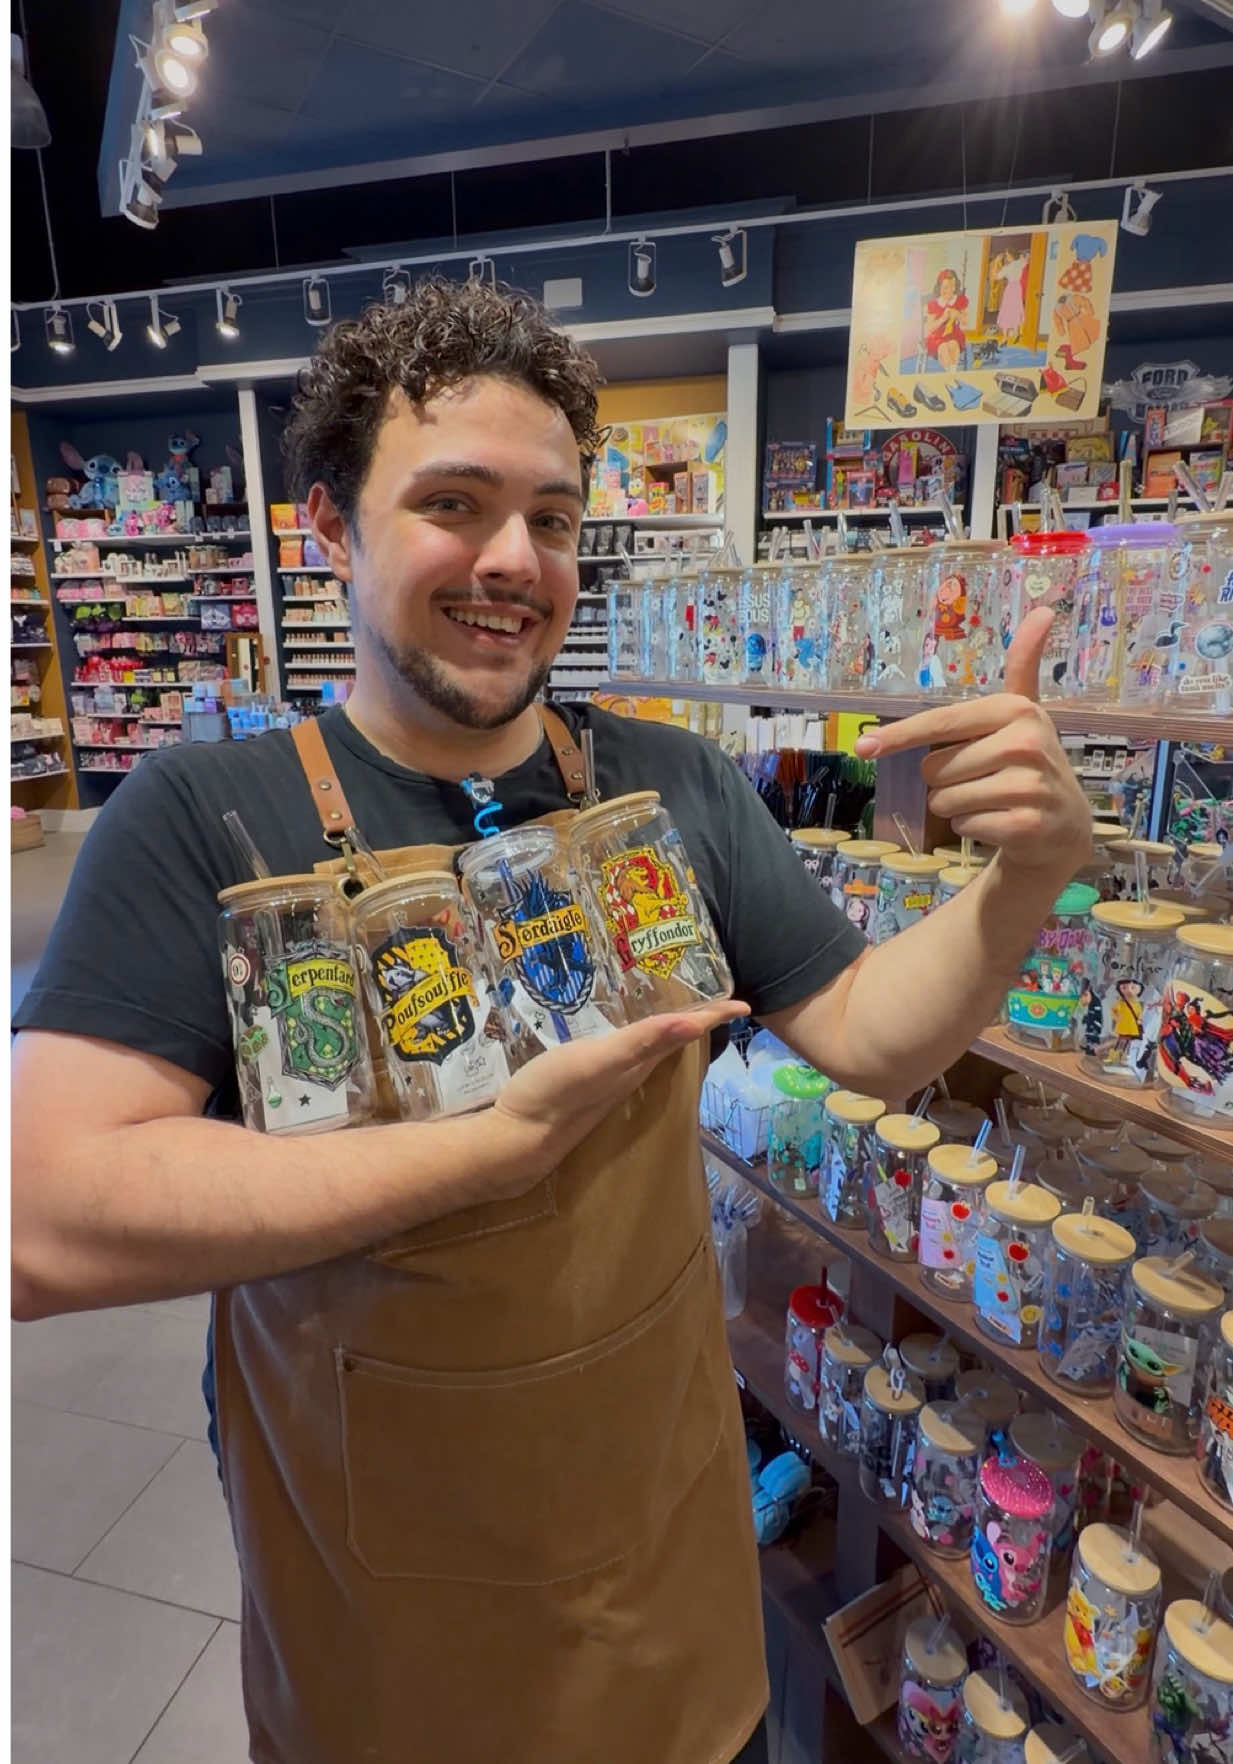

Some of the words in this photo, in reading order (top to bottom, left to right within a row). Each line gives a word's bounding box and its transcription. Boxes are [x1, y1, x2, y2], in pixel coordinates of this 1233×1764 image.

[1142, 368, 1188, 386] FORD
[883, 431, 954, 461] GASOLIN
[498, 910, 582, 959] Serdaigle
[383, 971, 469, 1030] Poufsouffle
